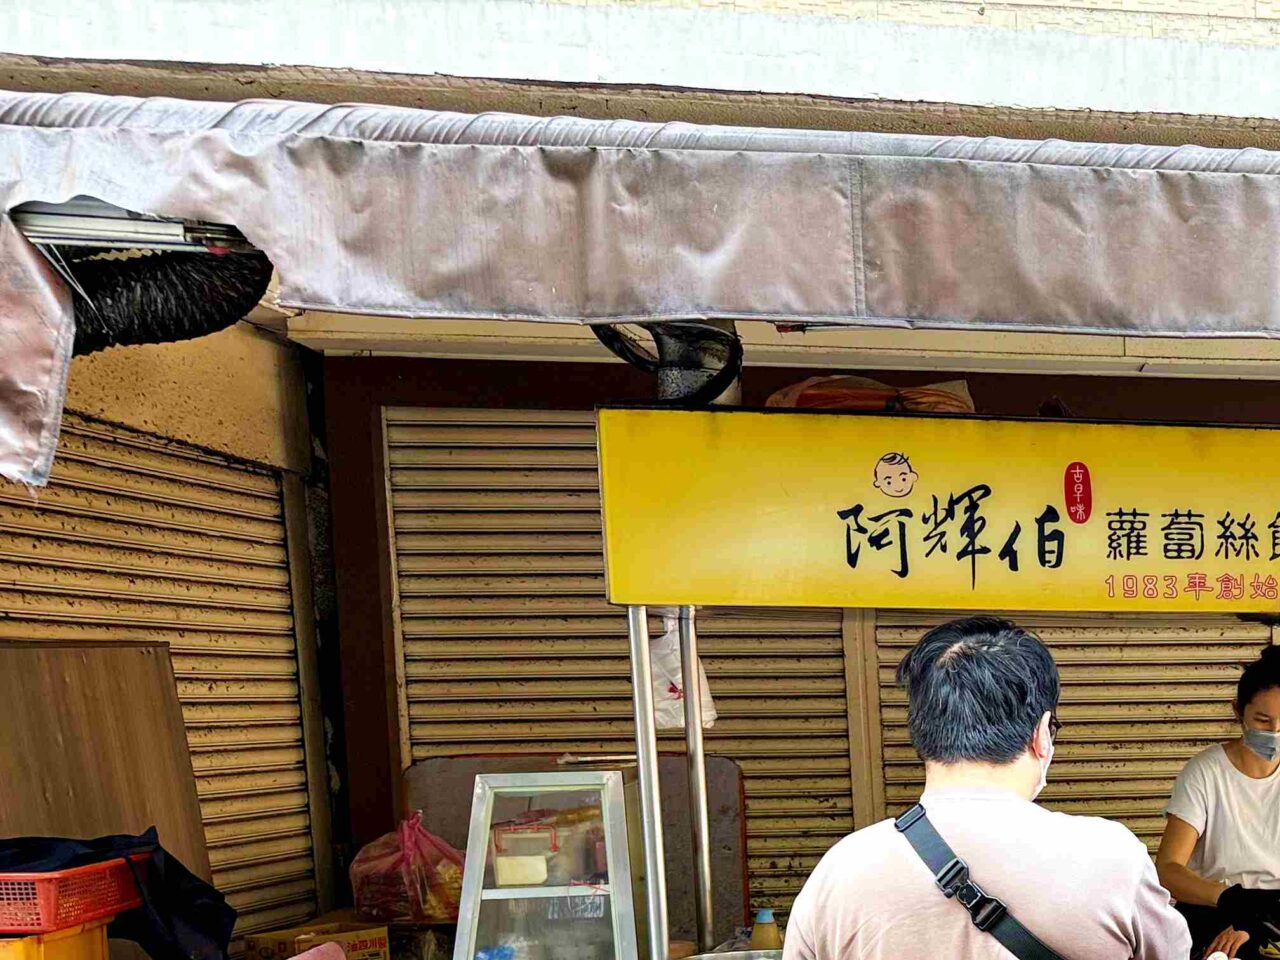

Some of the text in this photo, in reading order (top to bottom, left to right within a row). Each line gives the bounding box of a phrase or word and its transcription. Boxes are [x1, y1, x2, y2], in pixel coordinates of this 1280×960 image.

[1070, 465, 1086, 521] 古早味
[837, 484, 1065, 590] 阿輝伯
